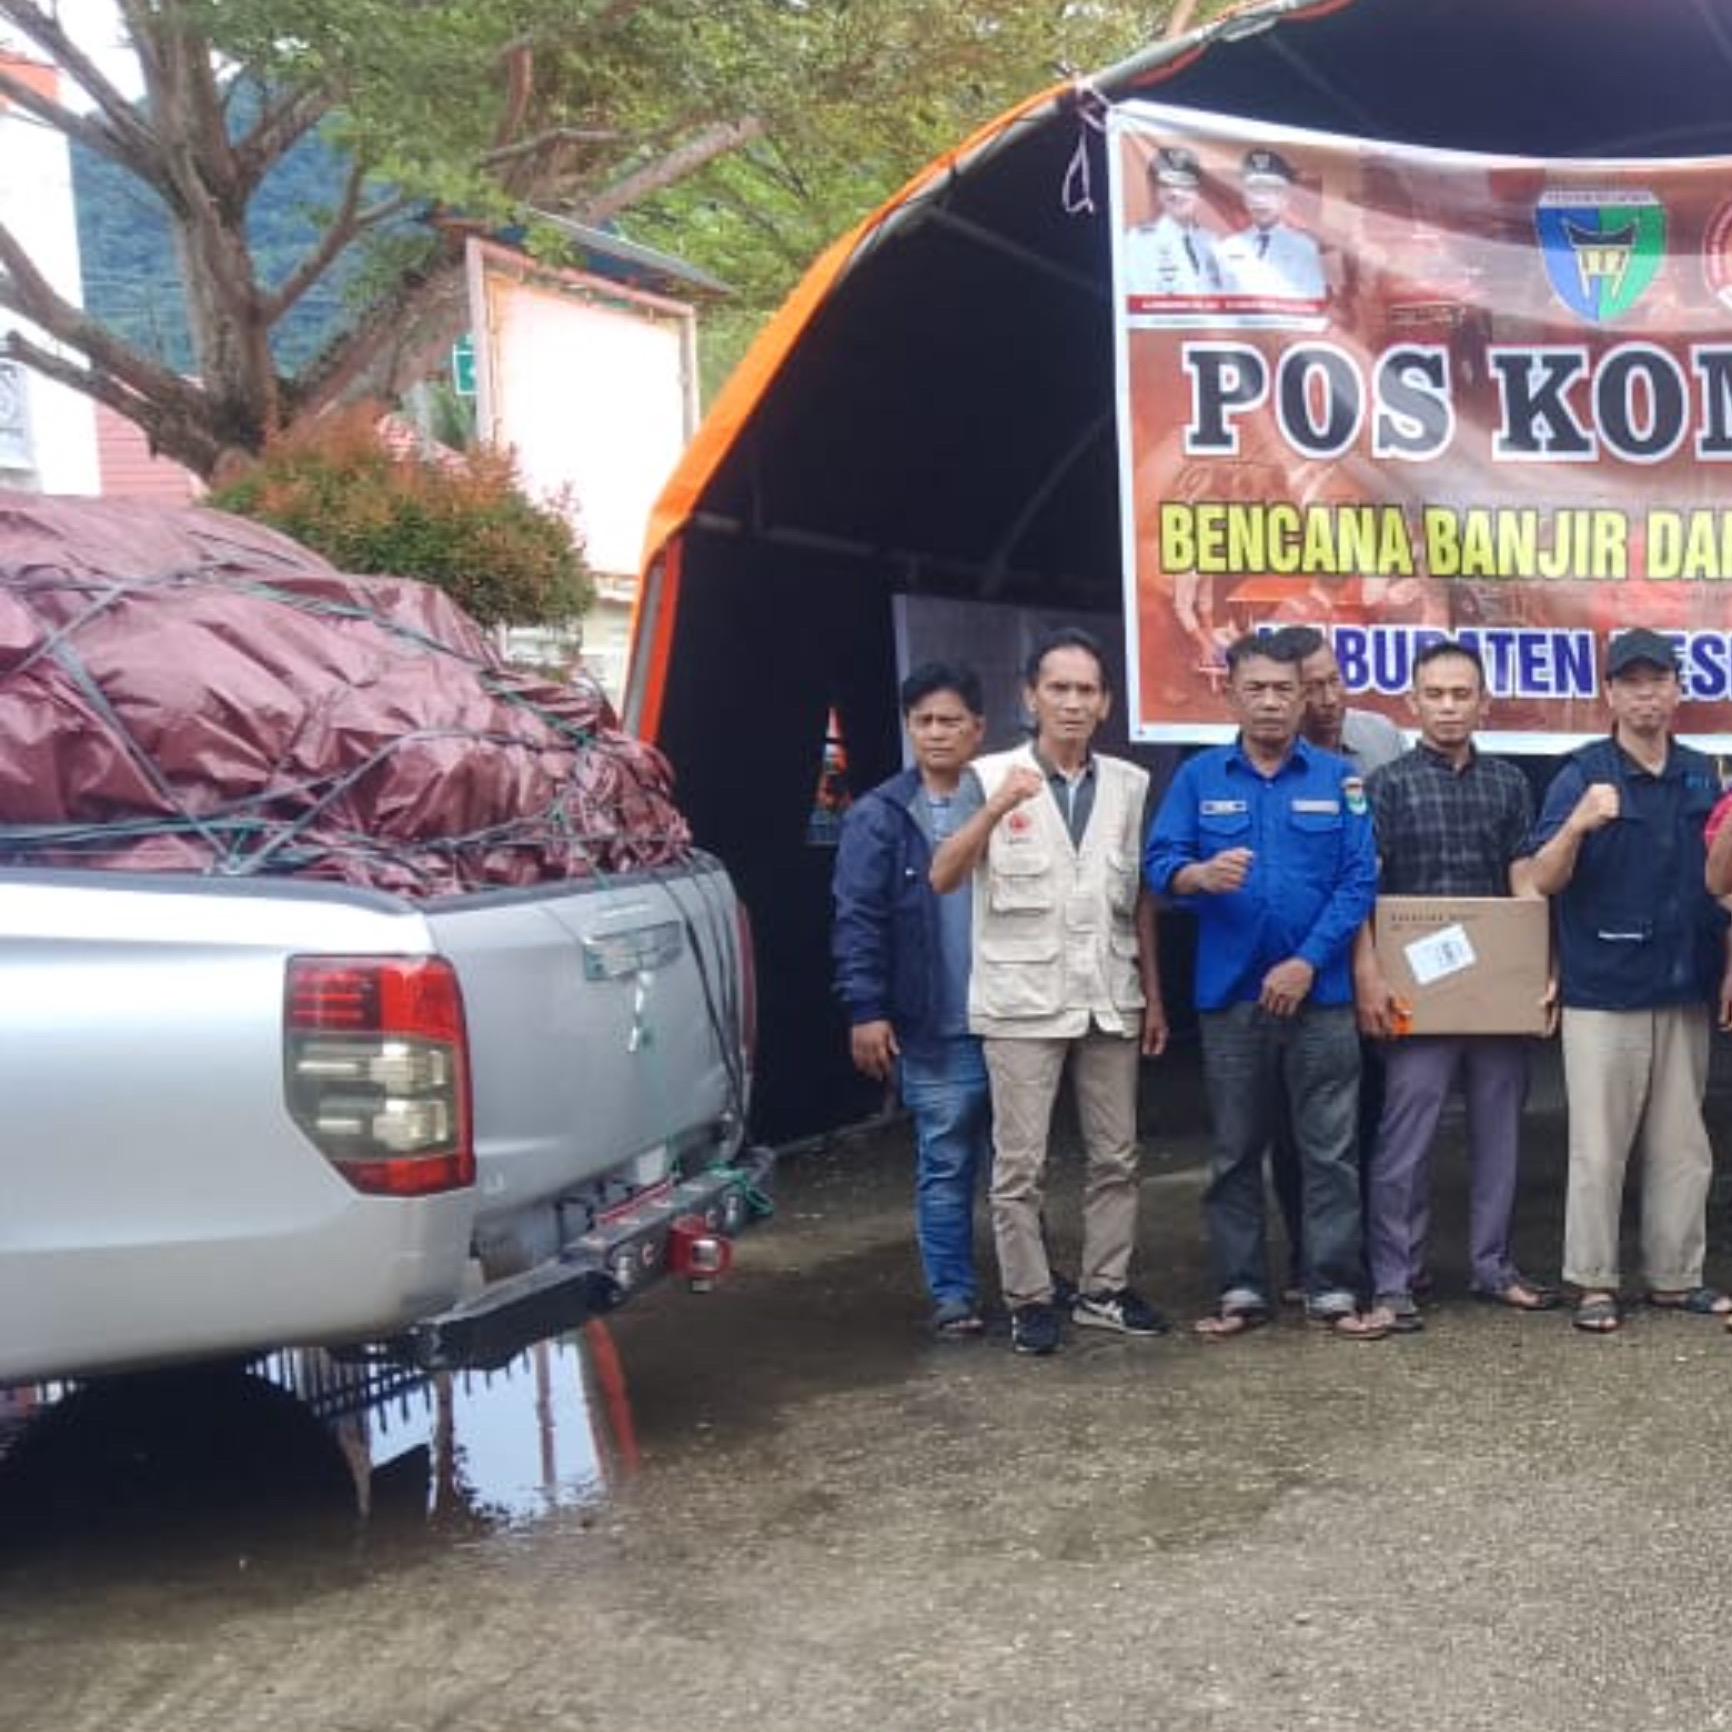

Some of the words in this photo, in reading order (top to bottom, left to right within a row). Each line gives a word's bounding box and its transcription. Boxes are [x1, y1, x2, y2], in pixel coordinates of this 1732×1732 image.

[1184, 343, 1453, 460] POS
[1159, 500, 1414, 577] BENCANA
[1424, 505, 1628, 580] BANJIR
